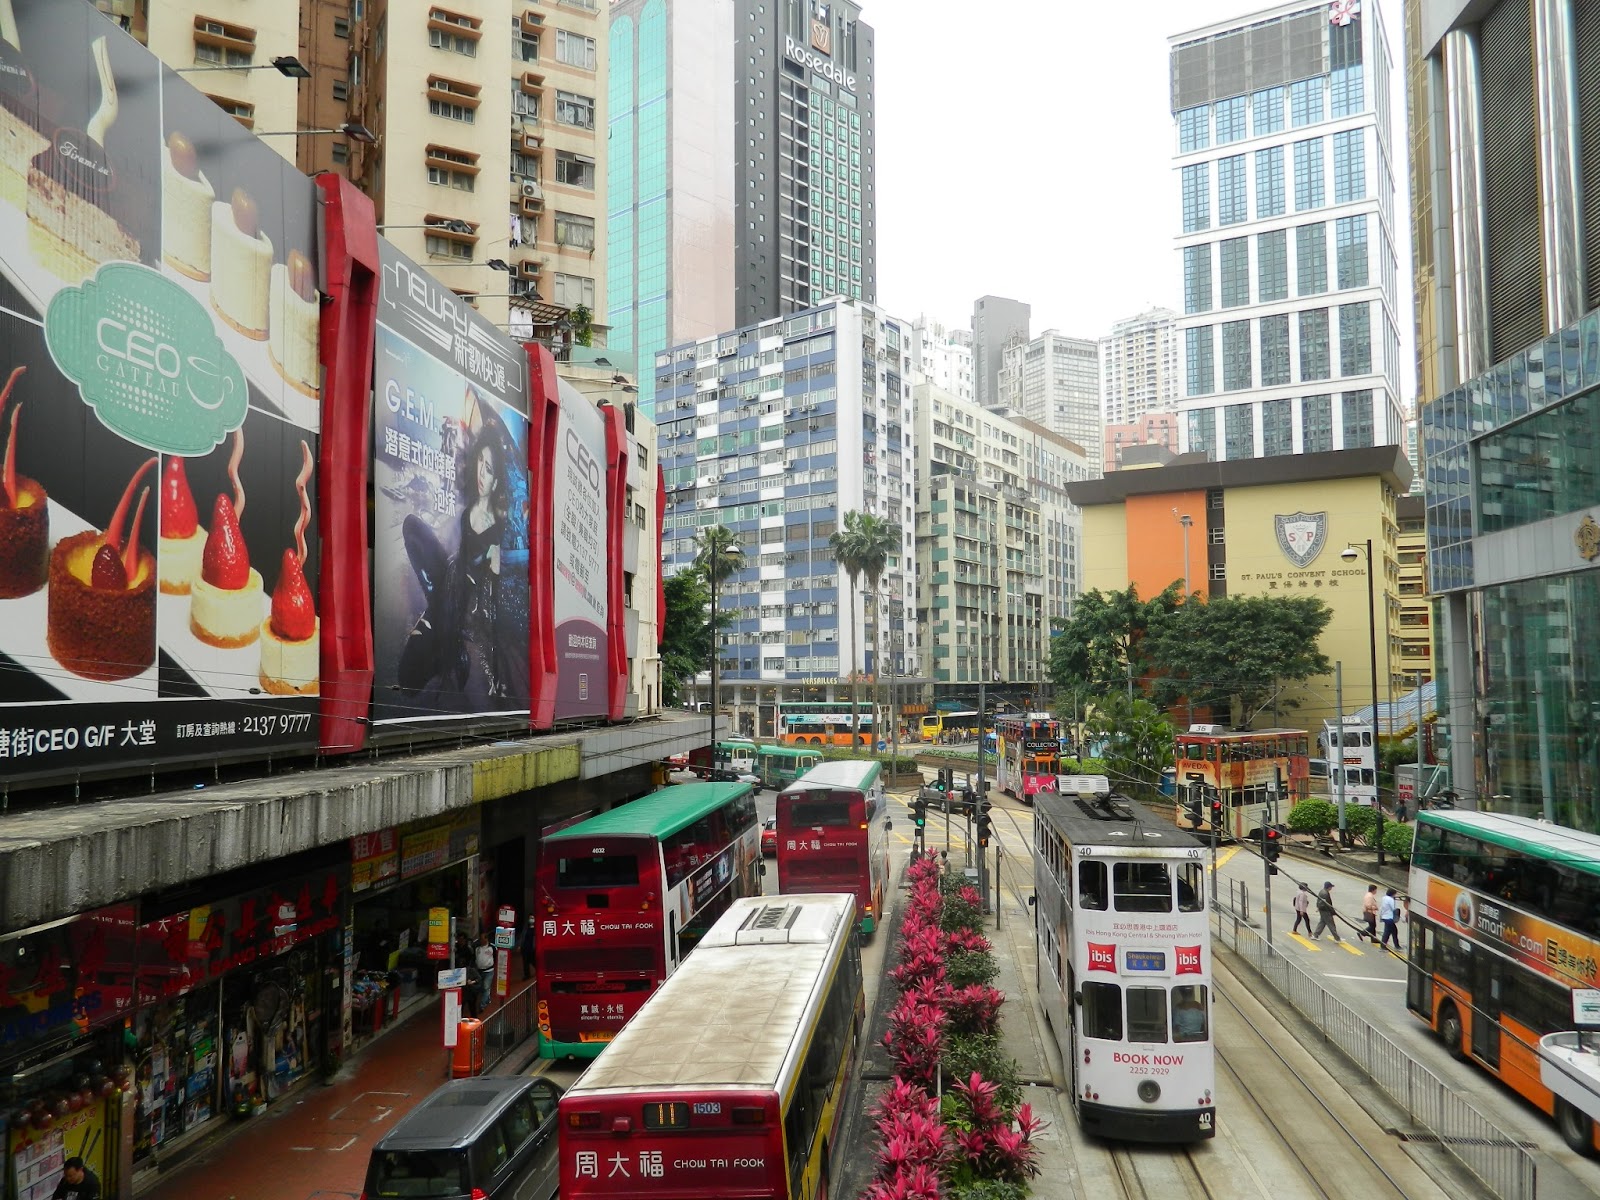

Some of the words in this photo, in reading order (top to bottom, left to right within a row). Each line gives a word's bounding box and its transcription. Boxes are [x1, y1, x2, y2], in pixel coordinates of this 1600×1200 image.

[786, 34, 856, 92] Rosedale
[60, 141, 98, 169] Tirami
[96, 317, 180, 378] CEO
[96, 354, 180, 397] GATEAU
[385, 379, 438, 432] G.E.M.
[566, 427, 600, 493] CEO
[1289, 532, 1296, 542] S
[1306, 532, 1314, 542] P
[84, 724, 116, 747] G/F
[120, 719, 156, 746] 大堂
[244, 716, 276, 736] 2137
[280, 714, 312, 734] 9777
[786, 840, 821, 850] 周大福
[1079, 847, 1092, 856] 40
[1187, 850, 1199, 858] 40
[542, 919, 595, 936] 周大福
[1092, 950, 1112, 963] ibis
[1179, 954, 1198, 965] ibis
[1114, 1052, 1149, 1065] BOOK
[1154, 1055, 1184, 1065] NOW
[658, 1103, 675, 1125] 11
[694, 1102, 720, 1114] 1503
[1199, 1112, 1211, 1124] 40
[576, 1151, 664, 1178] 周大福
[674, 1159, 706, 1169] CHOW
[710, 1159, 728, 1168] TAI
[734, 1158, 764, 1168] FOOK
